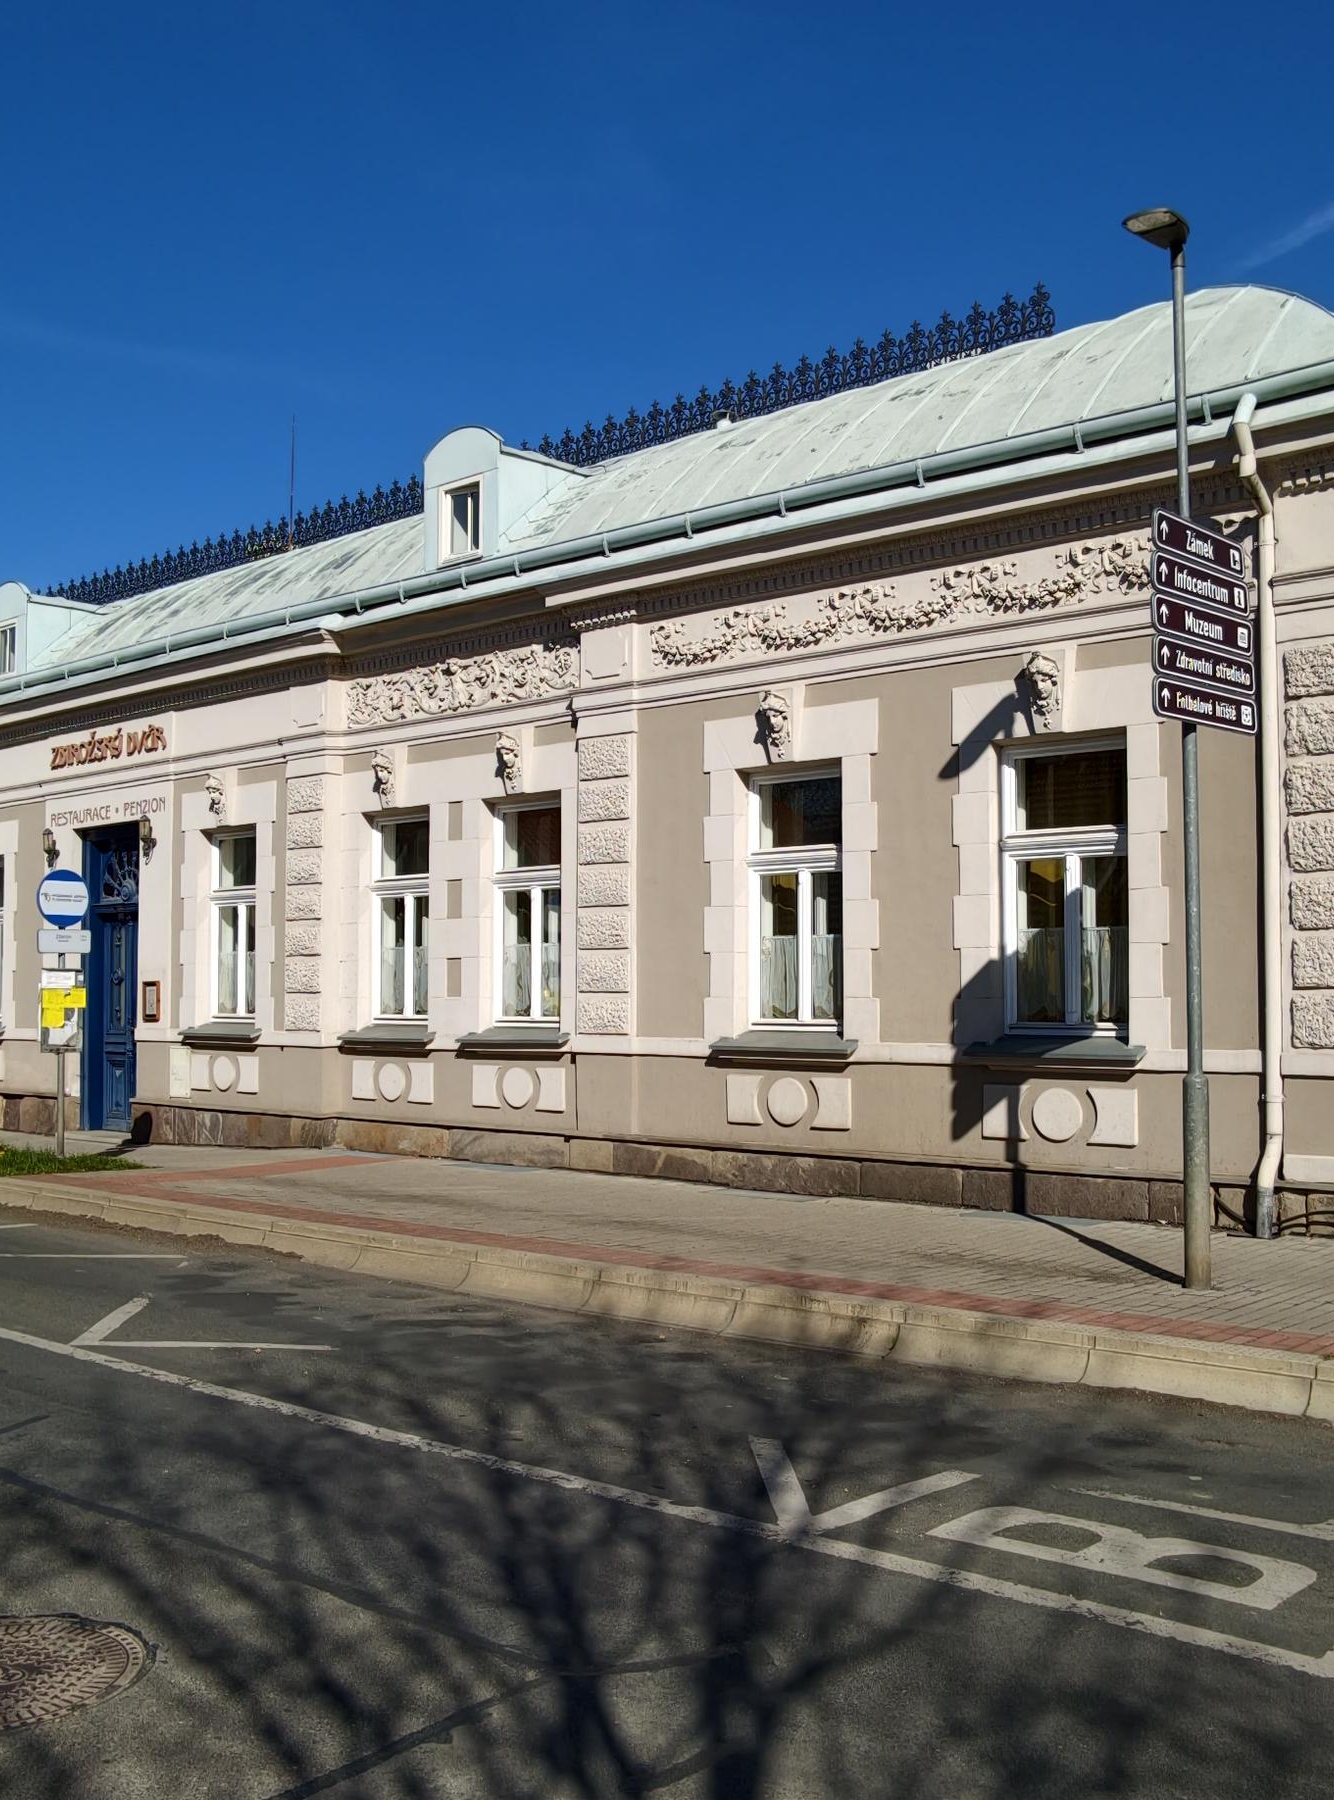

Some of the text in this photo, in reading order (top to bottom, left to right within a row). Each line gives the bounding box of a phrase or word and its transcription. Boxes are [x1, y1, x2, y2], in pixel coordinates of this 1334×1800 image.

[1186, 530, 1214, 561] Zámek
[1174, 566, 1229, 604] Infocentrum
[1184, 610, 1223, 641] Muzeum
[1176, 649, 1251, 686] Zdravotní středisko
[1215, 701, 1237, 721] hřiště
[126, 724, 168, 757] DVŮR
[50, 797, 166, 828] RESTAURACE PENZION
